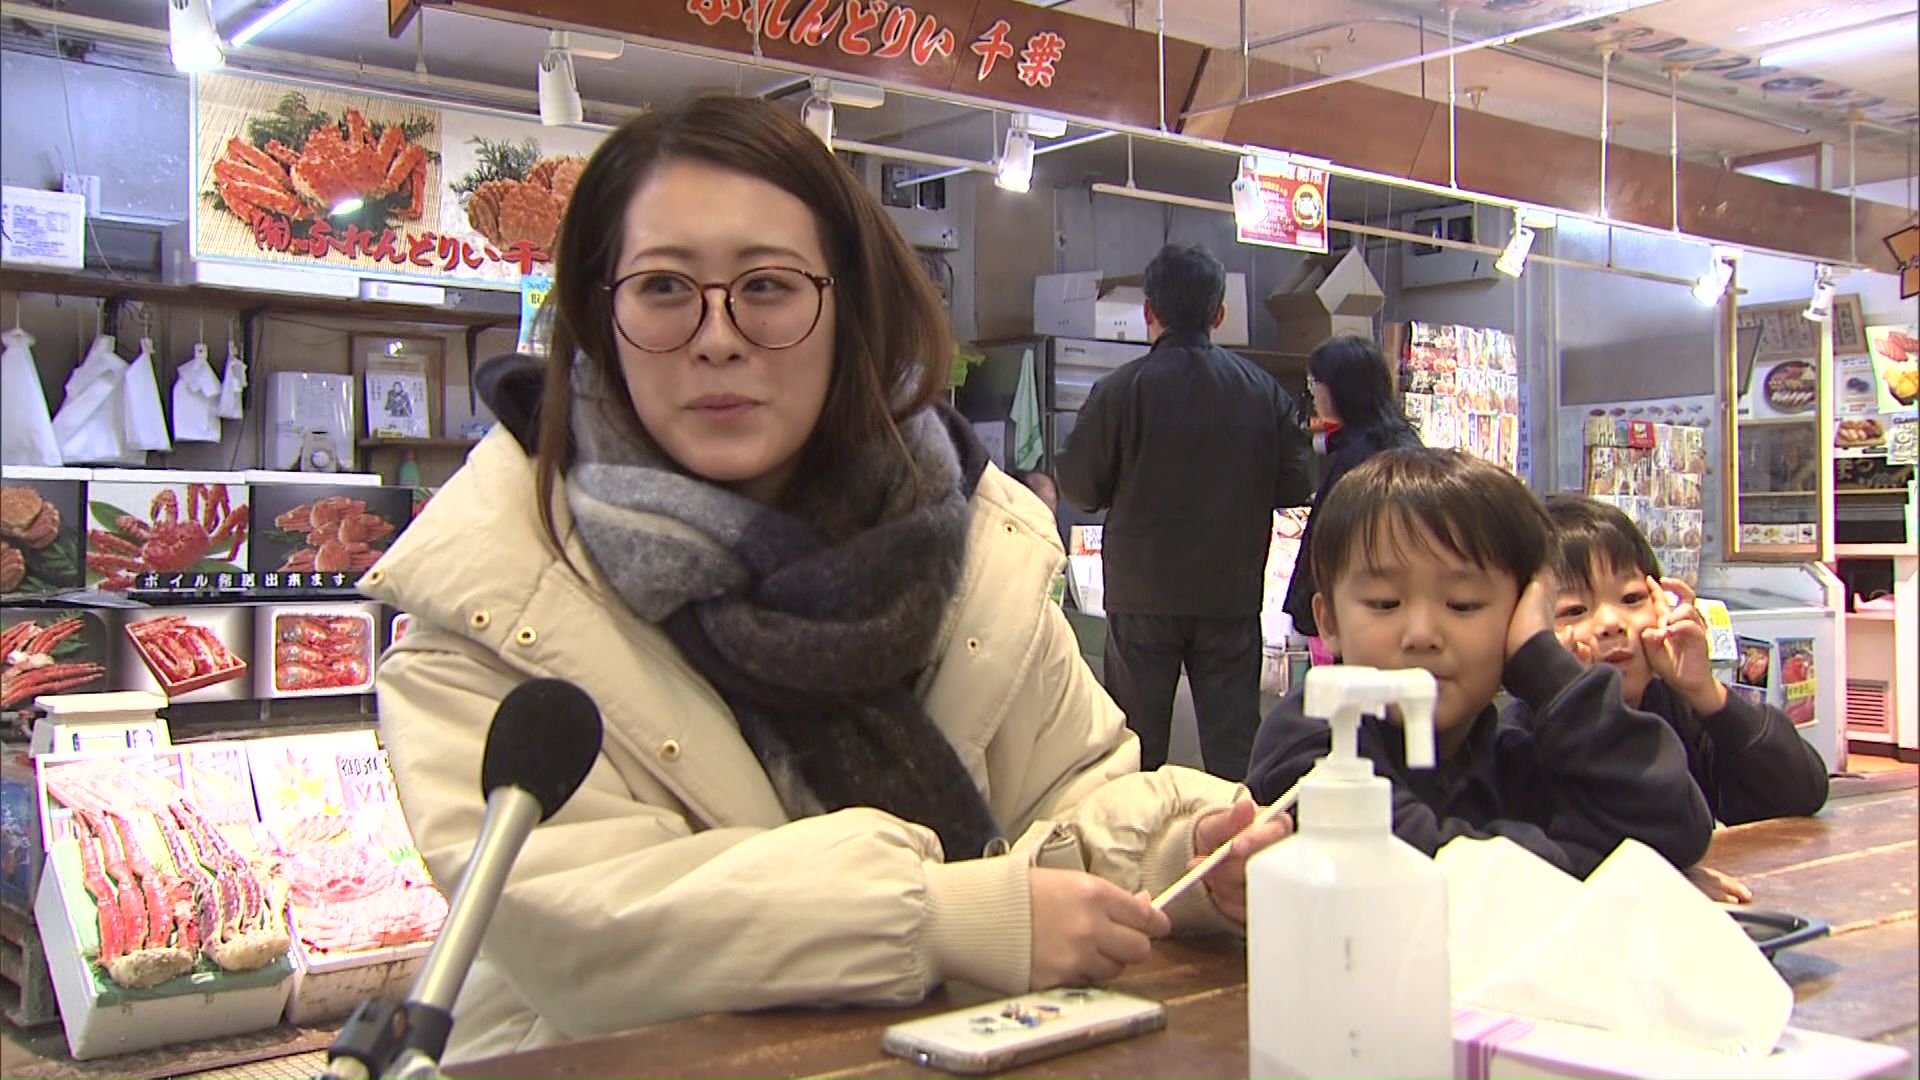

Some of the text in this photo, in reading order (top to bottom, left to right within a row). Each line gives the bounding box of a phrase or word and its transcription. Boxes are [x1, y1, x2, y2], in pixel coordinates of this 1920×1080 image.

[971, 20, 1066, 88] 千葉
[144, 572, 346, 588] ボイル発送出来ます
